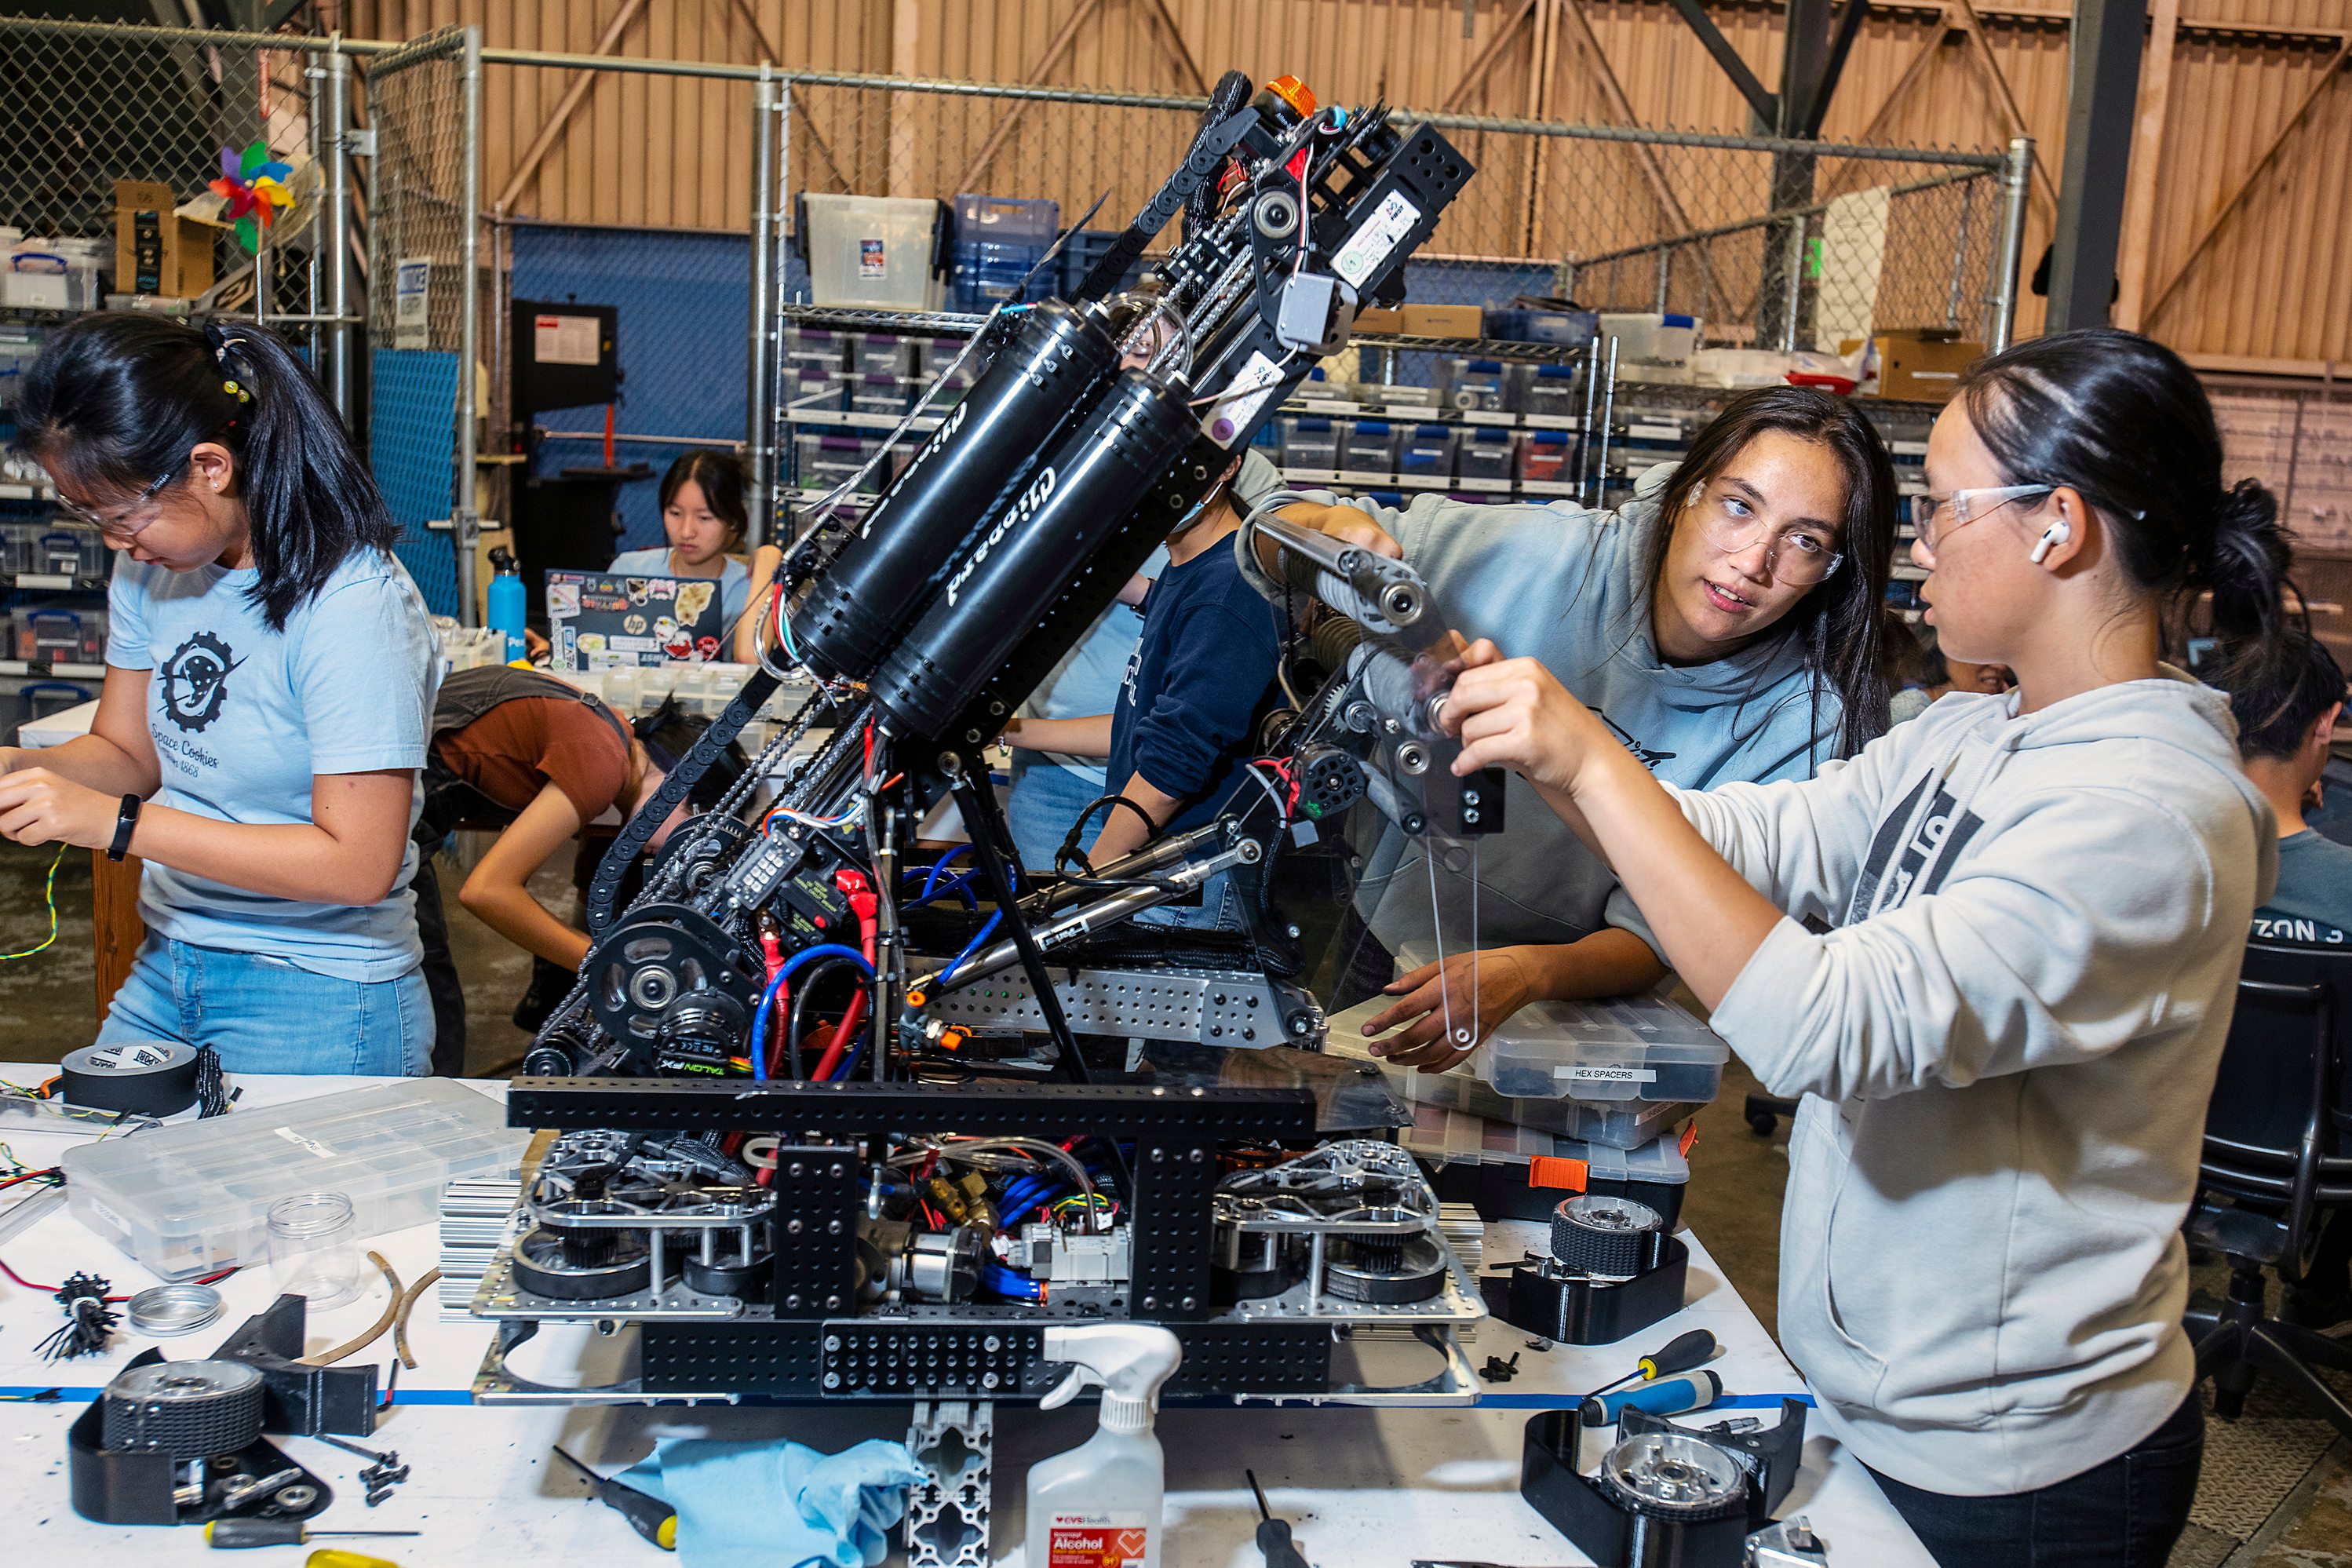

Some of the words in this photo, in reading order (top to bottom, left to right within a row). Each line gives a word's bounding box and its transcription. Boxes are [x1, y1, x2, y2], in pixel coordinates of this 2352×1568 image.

[1391, 204, 1405, 221] FIRST
[946, 466, 1056, 607] Clippard
[627, 614, 644, 635] hp
[151, 723, 180, 750] Space
[181, 740, 220, 769] Cookies
[181, 760, 200, 778] 1868
[1045, 926, 1078, 946] Parker
[661, 1059, 685, 1070] FX
[684, 1063, 725, 1076] TALON
[1575, 1070, 1592, 1078] HEX
[1594, 1070, 1633, 1079] SPACERS
[1053, 1537, 1103, 1550] Alcohol
